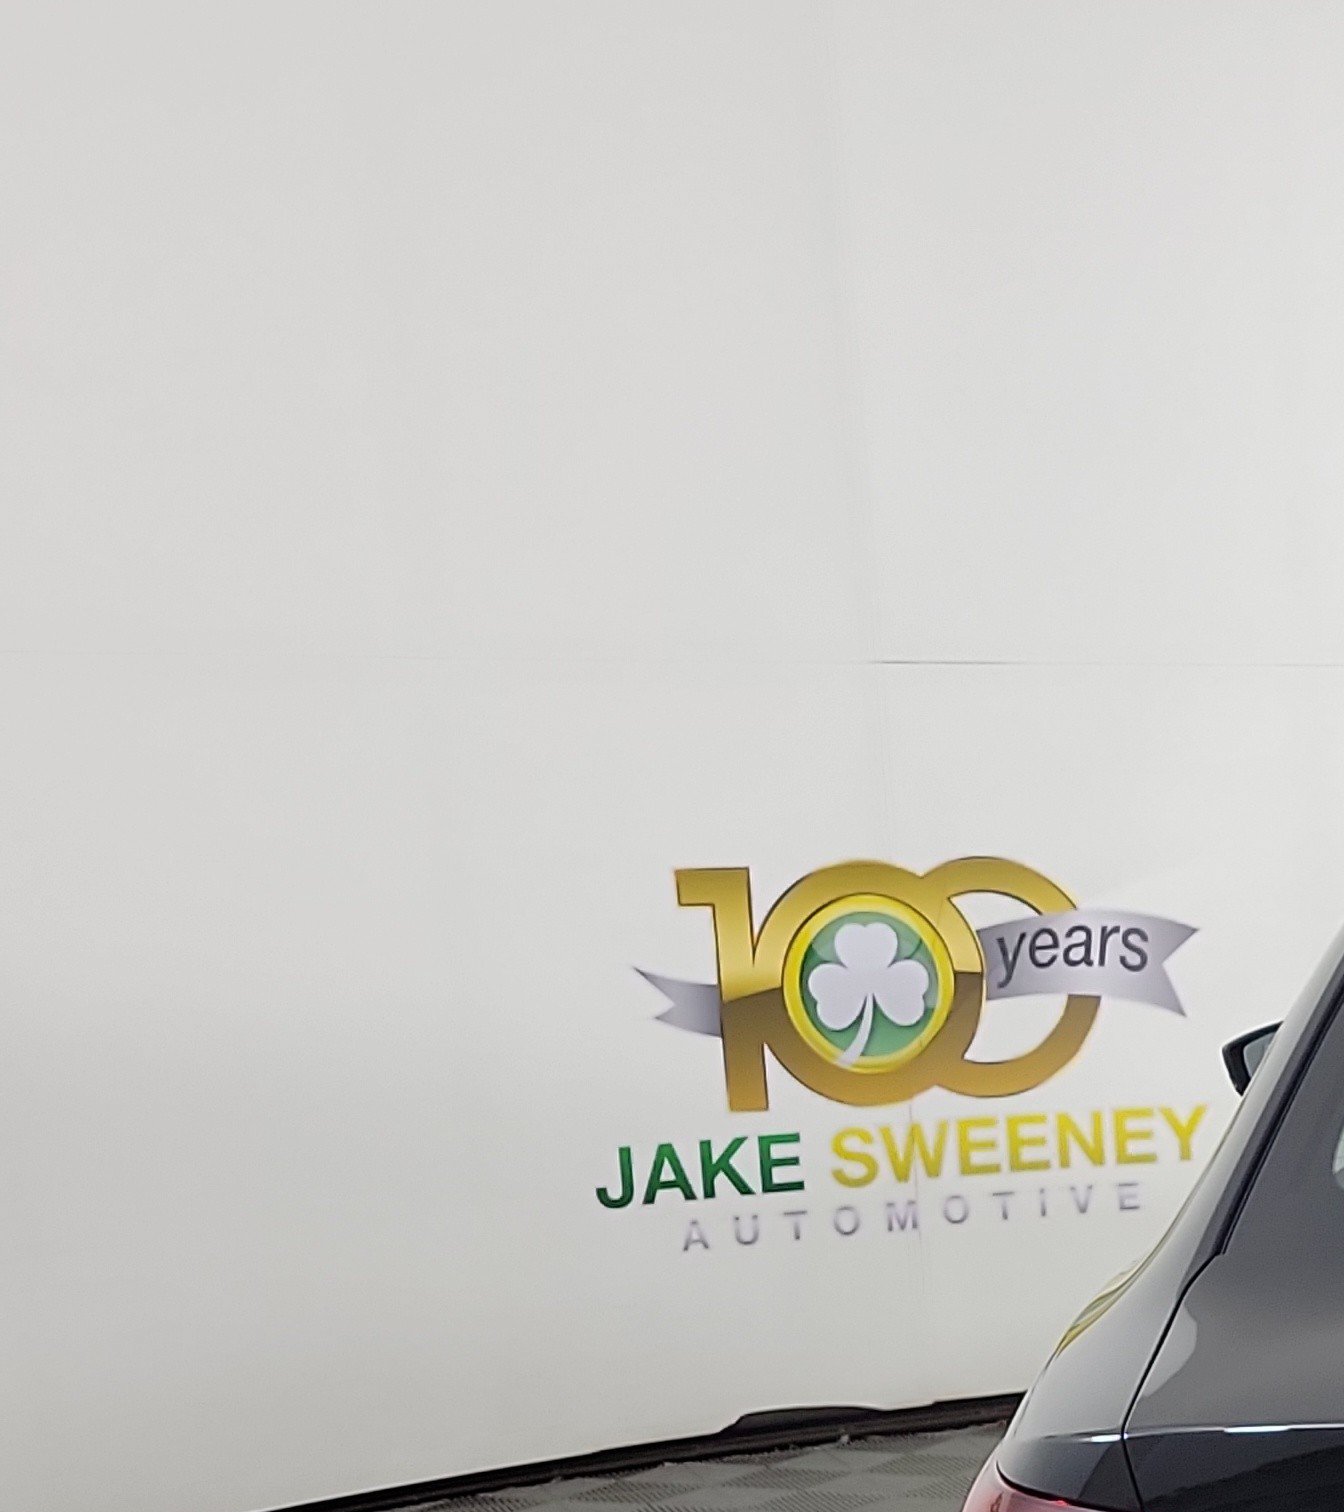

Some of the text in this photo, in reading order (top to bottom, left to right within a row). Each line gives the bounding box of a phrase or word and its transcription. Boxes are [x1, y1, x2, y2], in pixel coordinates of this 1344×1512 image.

[674, 855, 1150, 1112] 100 years
[595, 1104, 1209, 1209] JAKE SWEENEY
[682, 1182, 1142, 1253] AUTOMOTIVE
